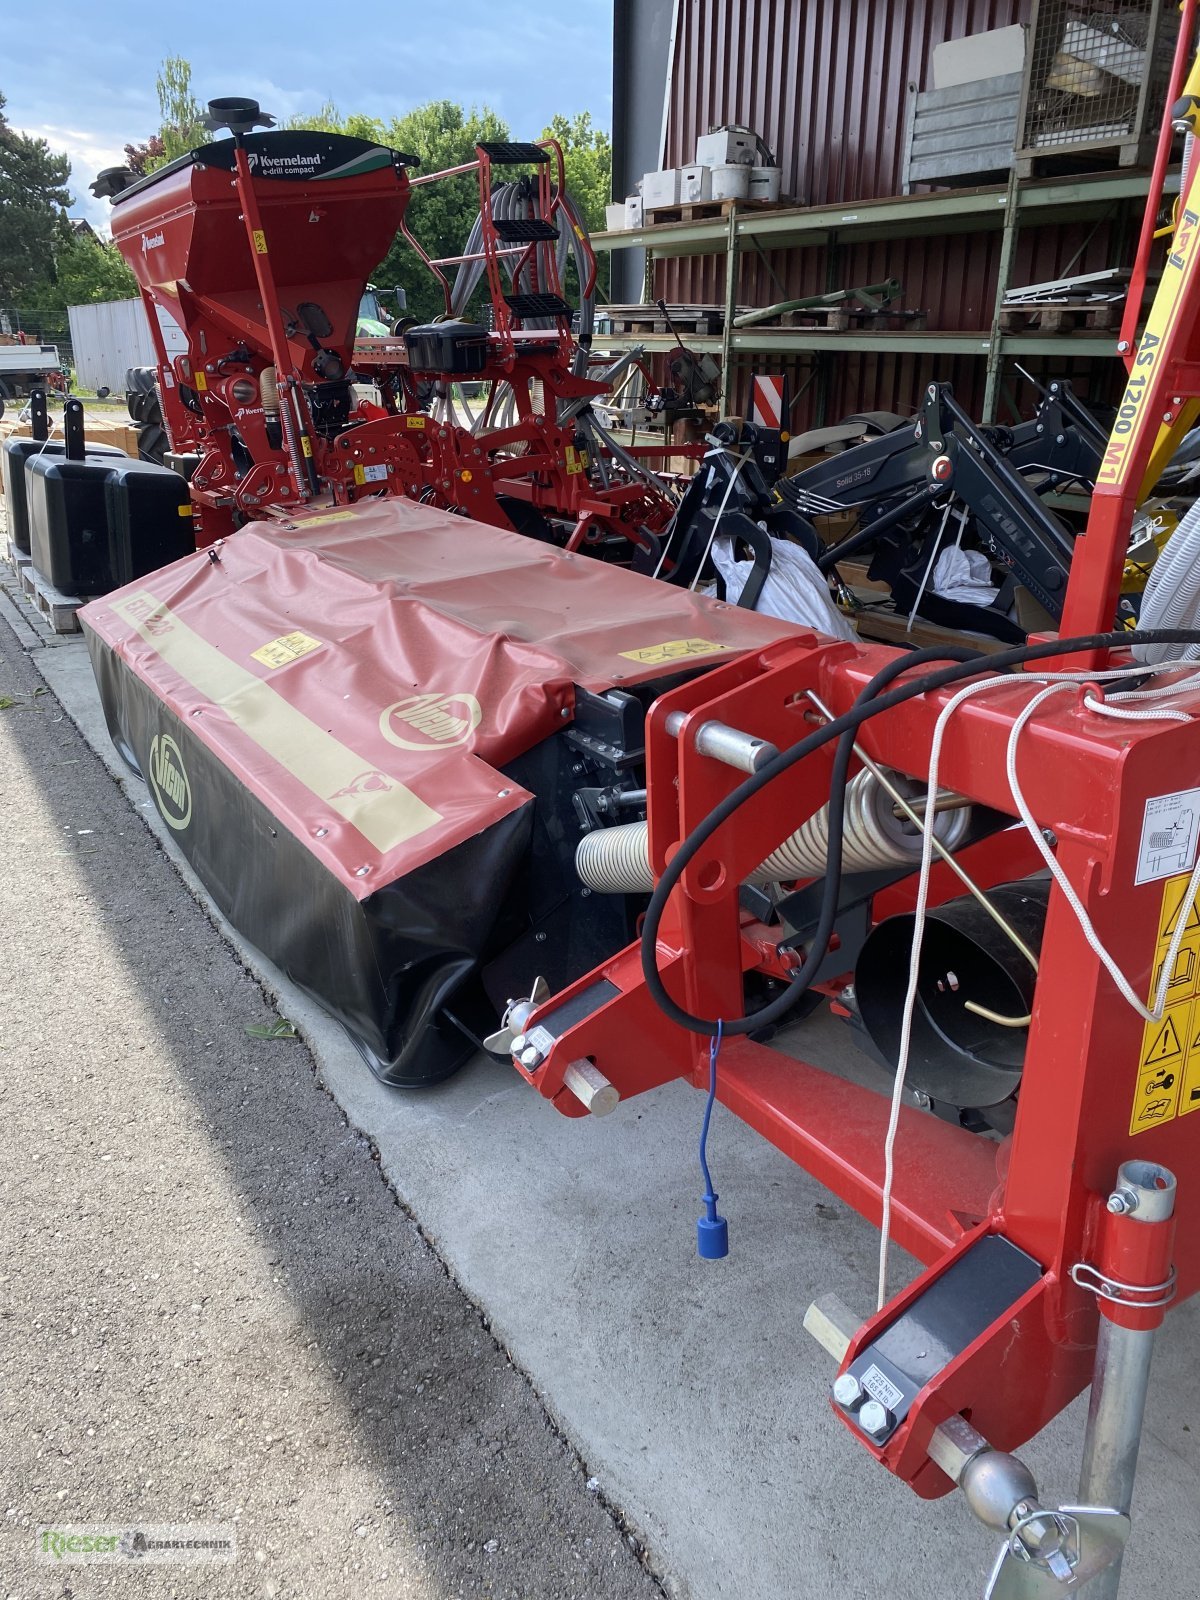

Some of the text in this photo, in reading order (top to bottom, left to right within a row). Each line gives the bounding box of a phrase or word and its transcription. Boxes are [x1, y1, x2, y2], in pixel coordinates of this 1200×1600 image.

[260, 153, 321, 167] Kverneland
[262, 165, 315, 175] e-drill compact
[1099, 331, 1161, 484] AS 1200 M1
[836, 474, 853, 488] Solid
[143, 614, 175, 637] 228
[392, 692, 470, 742] Vicon
[152, 733, 188, 814] Vicon
[867, 1379, 878, 1392] 165
[876, 1389, 883, 1397] ft
[872, 1373, 894, 1397] 225 Nm
